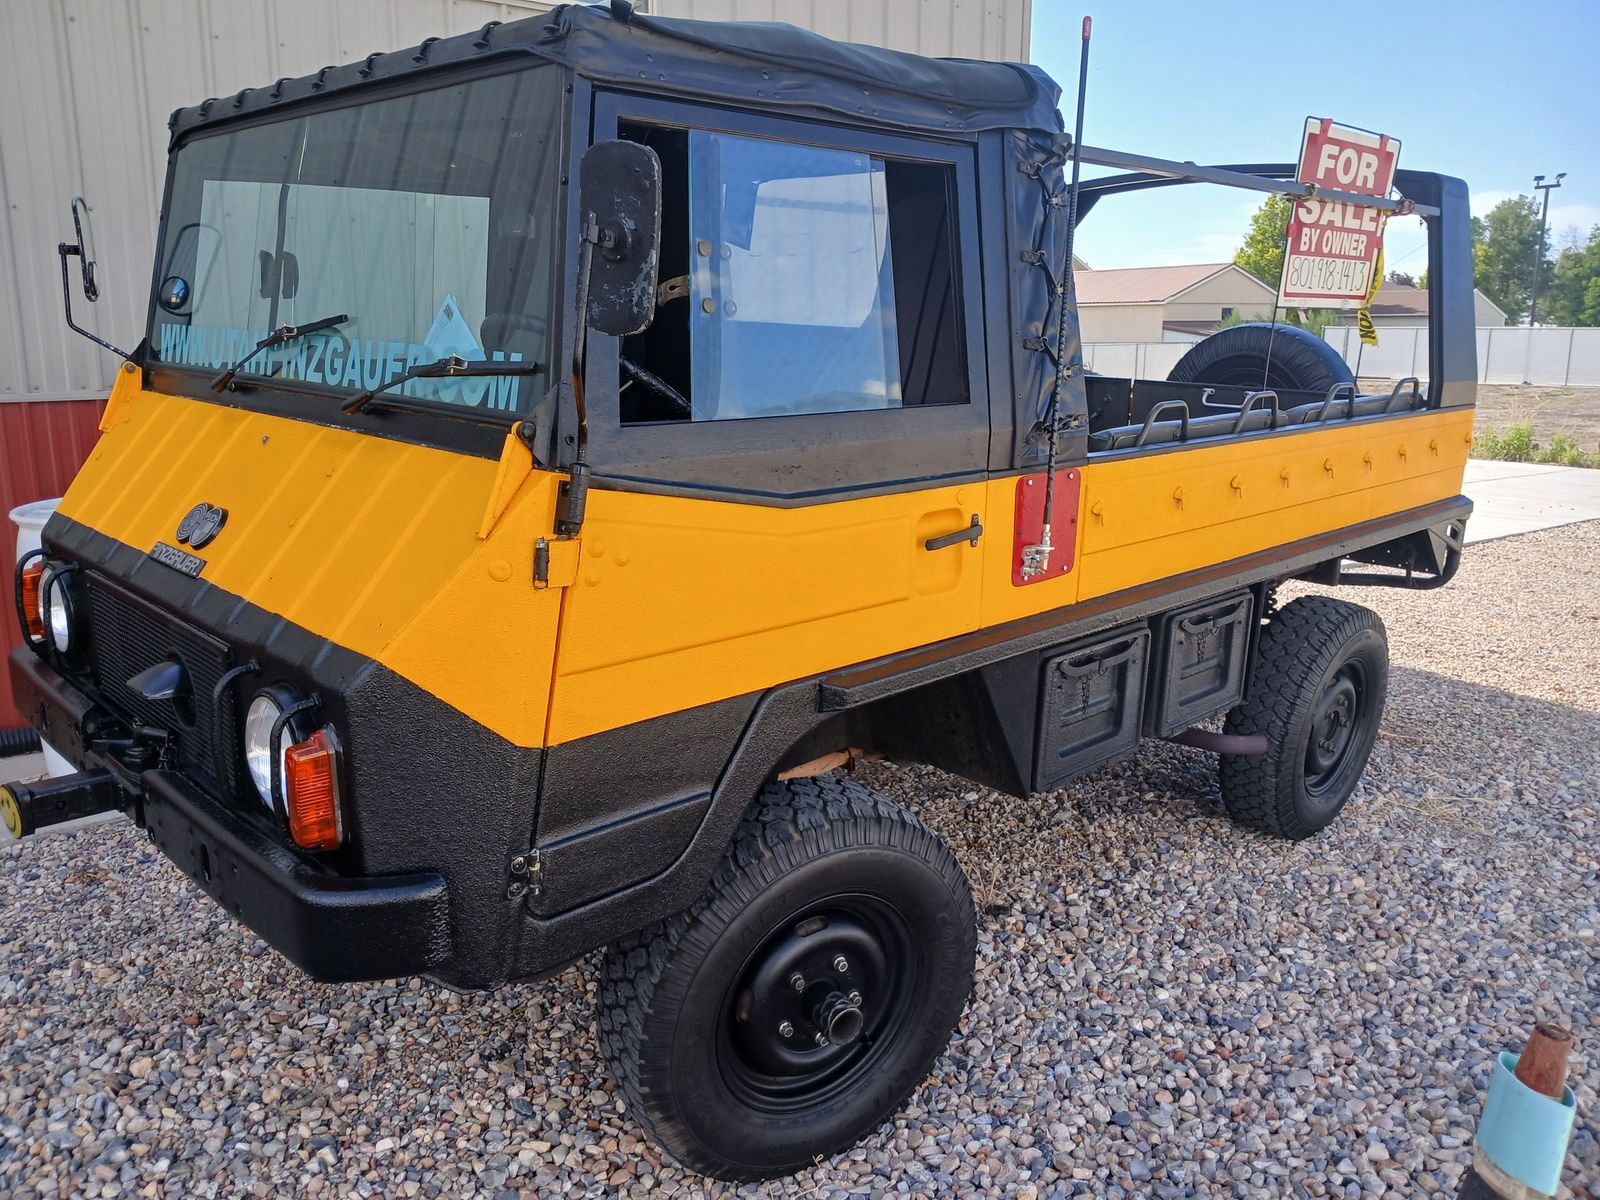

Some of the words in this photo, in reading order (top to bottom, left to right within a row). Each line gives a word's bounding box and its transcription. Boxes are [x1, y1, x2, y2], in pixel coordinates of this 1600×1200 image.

[1316, 143, 1379, 189] FOR
[1297, 183, 1383, 232] SALE
[1300, 227, 1320, 253] BY
[1322, 229, 1367, 257] OWNER
[150, 542, 201, 576] PINZGAUER
